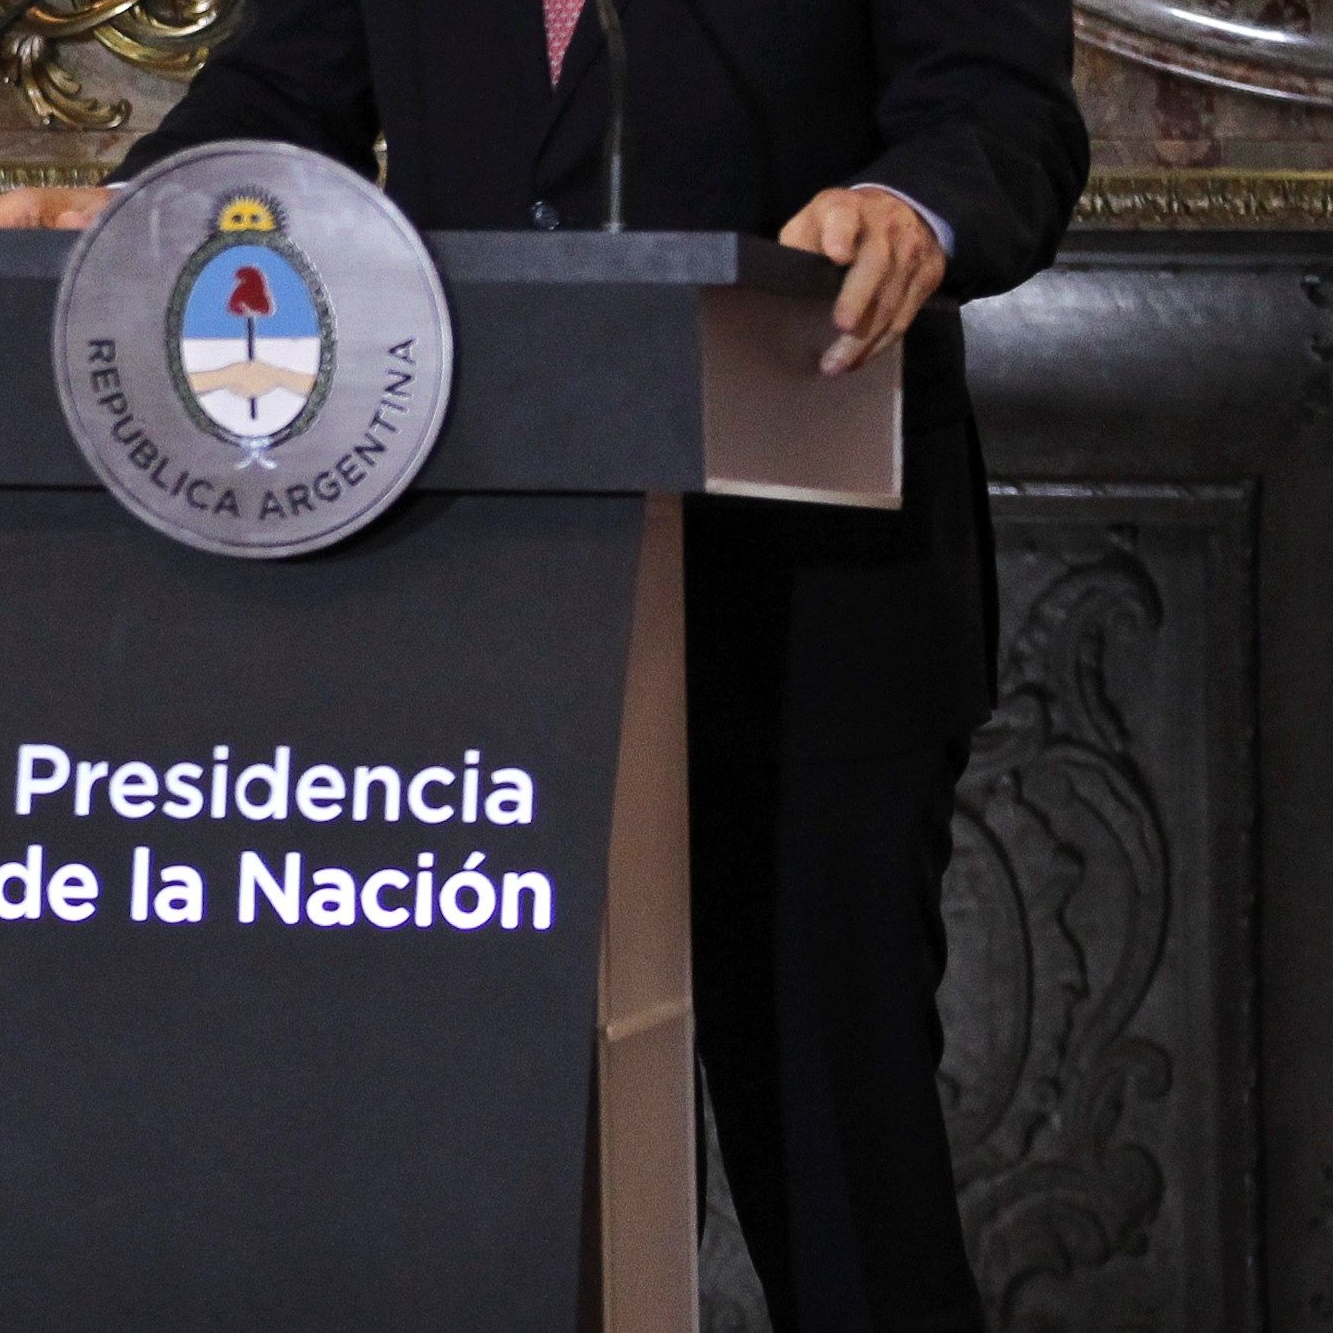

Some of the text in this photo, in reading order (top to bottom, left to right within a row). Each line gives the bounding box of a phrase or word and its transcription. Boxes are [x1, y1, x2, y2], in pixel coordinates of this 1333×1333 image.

[259, 337, 417, 520] ARGENTINA
[15, 743, 534, 826] Presidencia
[129, 845, 204, 924] la
[237, 850, 552, 931] Nación
